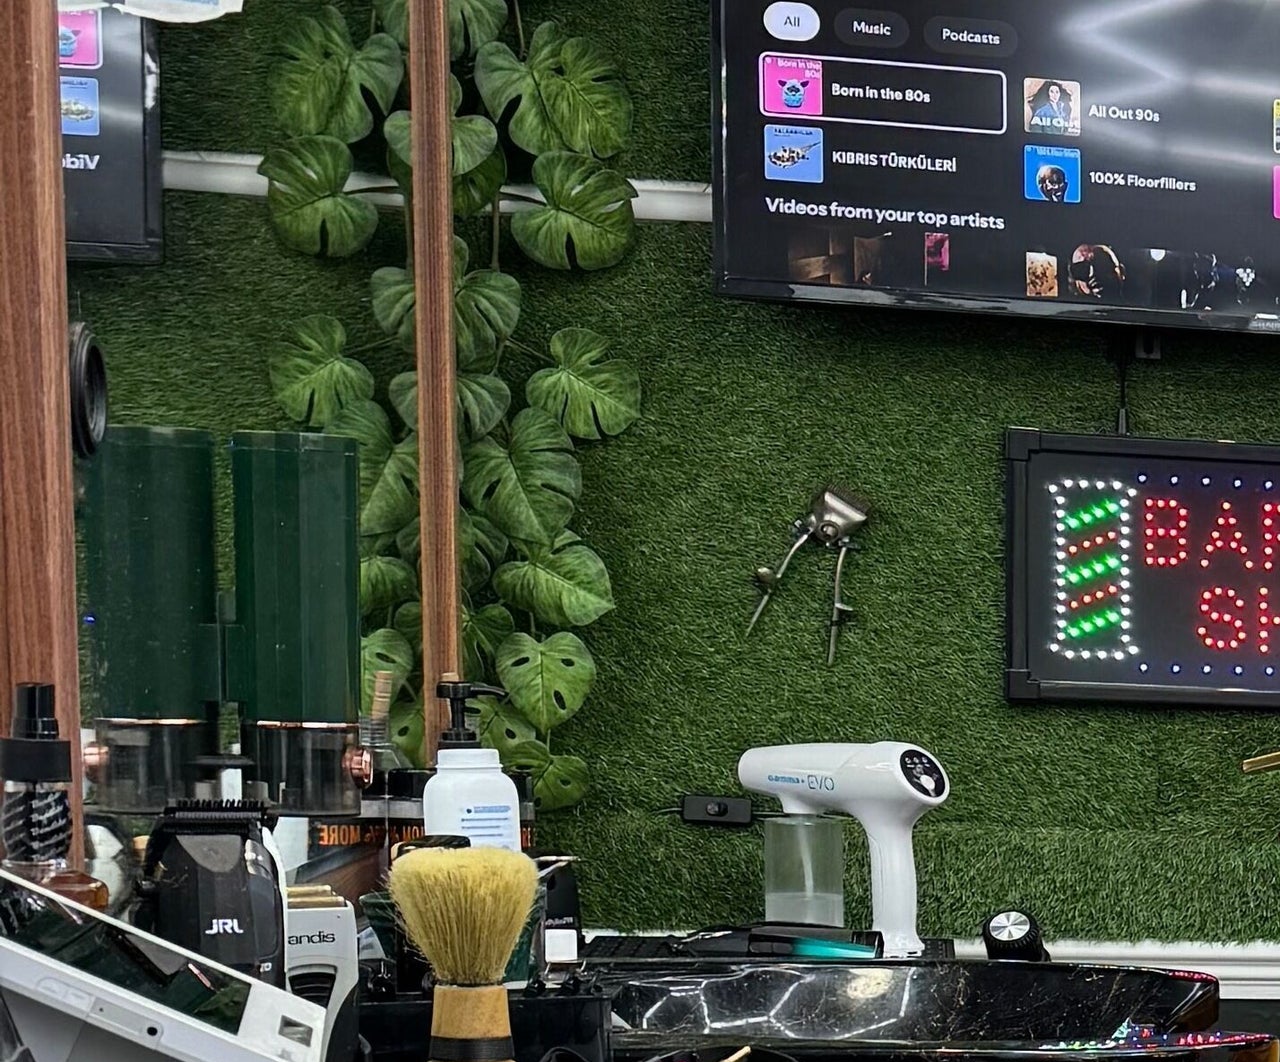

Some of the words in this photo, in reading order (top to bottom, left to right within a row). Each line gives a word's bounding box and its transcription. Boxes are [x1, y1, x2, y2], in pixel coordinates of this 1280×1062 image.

[784, 15, 801, 28] All
[852, 20, 892, 36] Music
[942, 28, 1001, 46] Podcasts
[831, 83, 865, 99] Born
[866, 85, 878, 100] in
[879, 86, 903, 102] the
[905, 88, 931, 103] 80s
[1089, 104, 1107, 118] All
[1108, 106, 1133, 120] Out
[1135, 108, 1160, 123] 90s
[832, 151, 879, 167] KIBRIS
[1089, 171, 1126, 187] 100%
[1127, 174, 1197, 192] Floorfillers
[765, 197, 828, 217] Videos
[829, 202, 873, 220] from
[875, 208, 916, 224] your
[917, 211, 948, 228] top
[949, 212, 1006, 230] artists
[205, 918, 244, 935] JRL
[287, 931, 336, 945] andis
